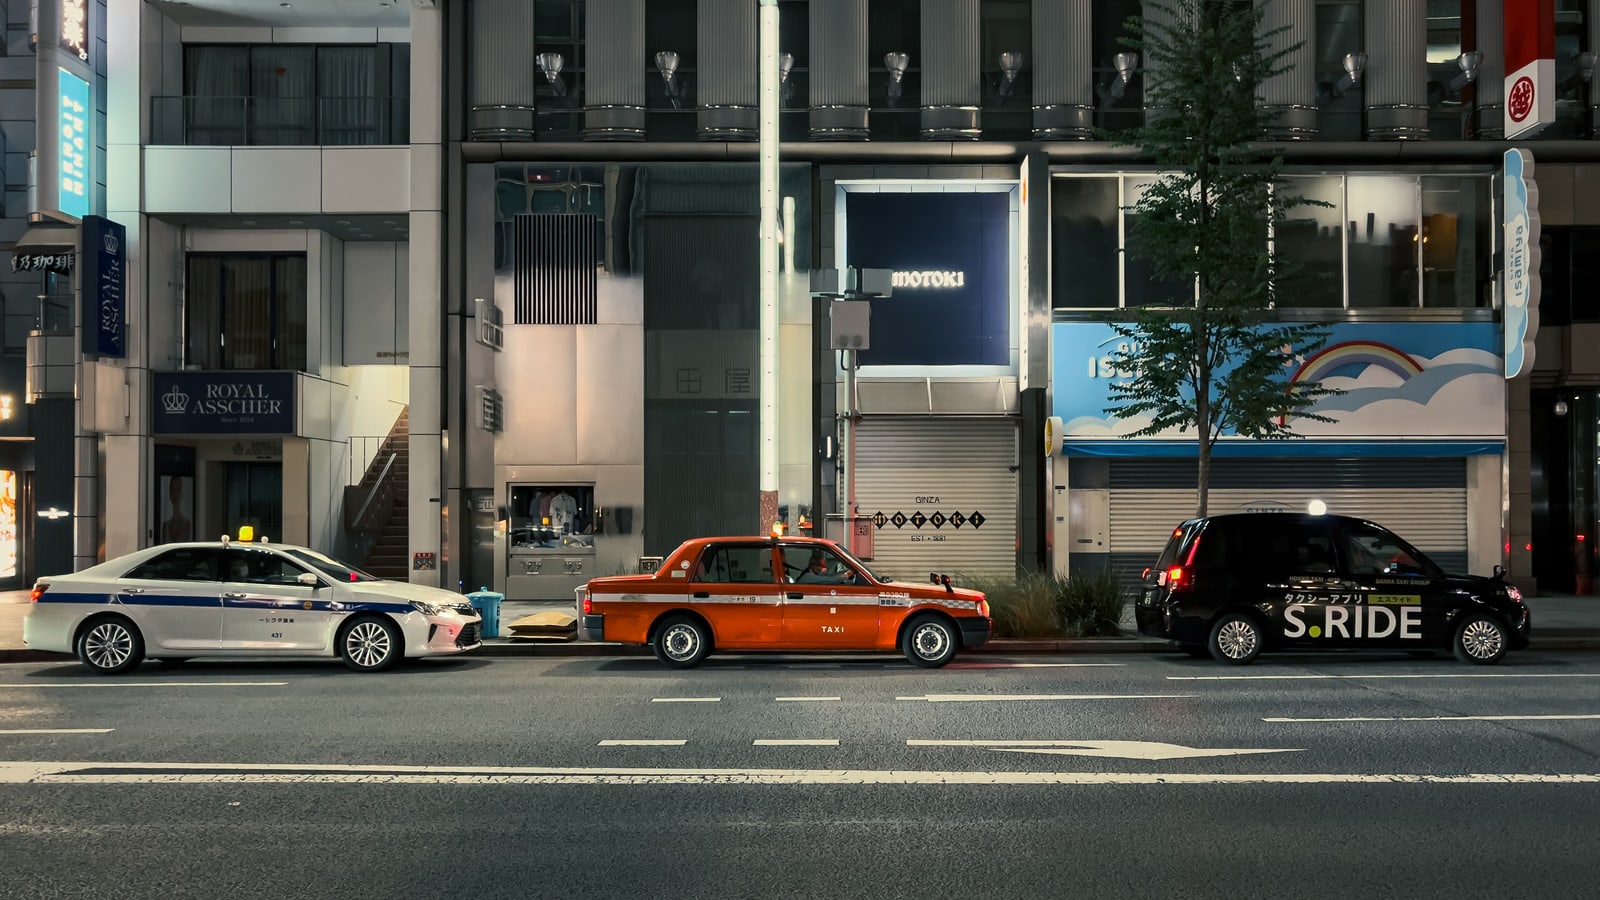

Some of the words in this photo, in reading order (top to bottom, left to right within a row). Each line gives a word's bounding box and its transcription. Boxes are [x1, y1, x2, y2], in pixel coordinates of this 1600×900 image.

[892, 270, 965, 288] MOTOKI
[102, 270, 111, 330] ROYAL
[111, 260, 120, 348] ASSCHER
[206, 384, 269, 398] ROYAL
[192, 400, 282, 414] ASSCHER
[915, 496, 940, 504] GINZA
[872, 513, 982, 526] MOTOKI
[1284, 593, 1363, 604] タクシーアプリ
[1284, 605, 1422, 639] S.RIDE
